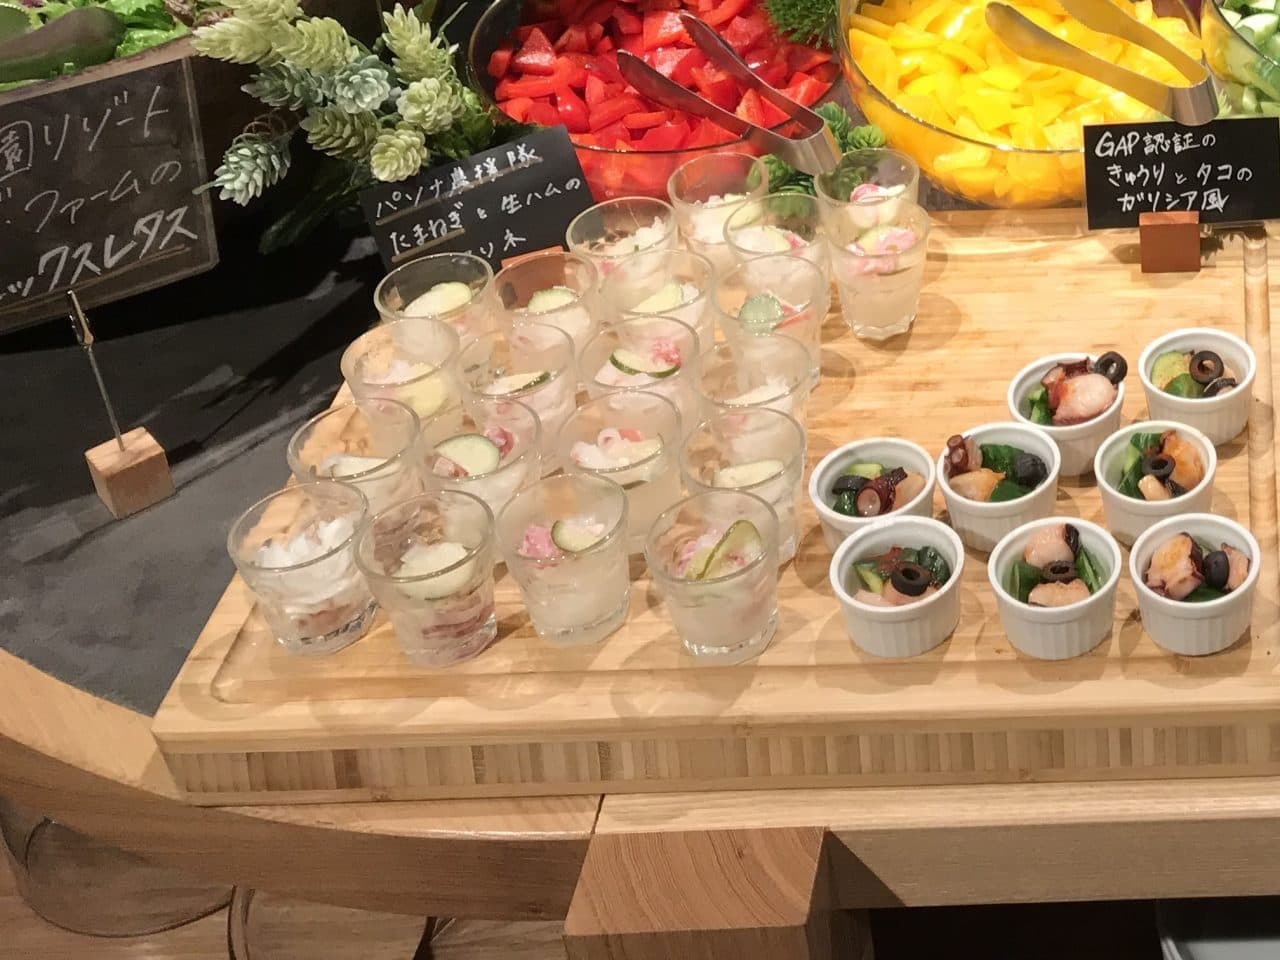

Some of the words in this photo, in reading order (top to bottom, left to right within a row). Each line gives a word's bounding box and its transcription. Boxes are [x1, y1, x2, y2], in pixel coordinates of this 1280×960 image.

[389, 177, 582, 256] たまねぎと生ハムの
[1116, 187, 1230, 213] ガリシア風
